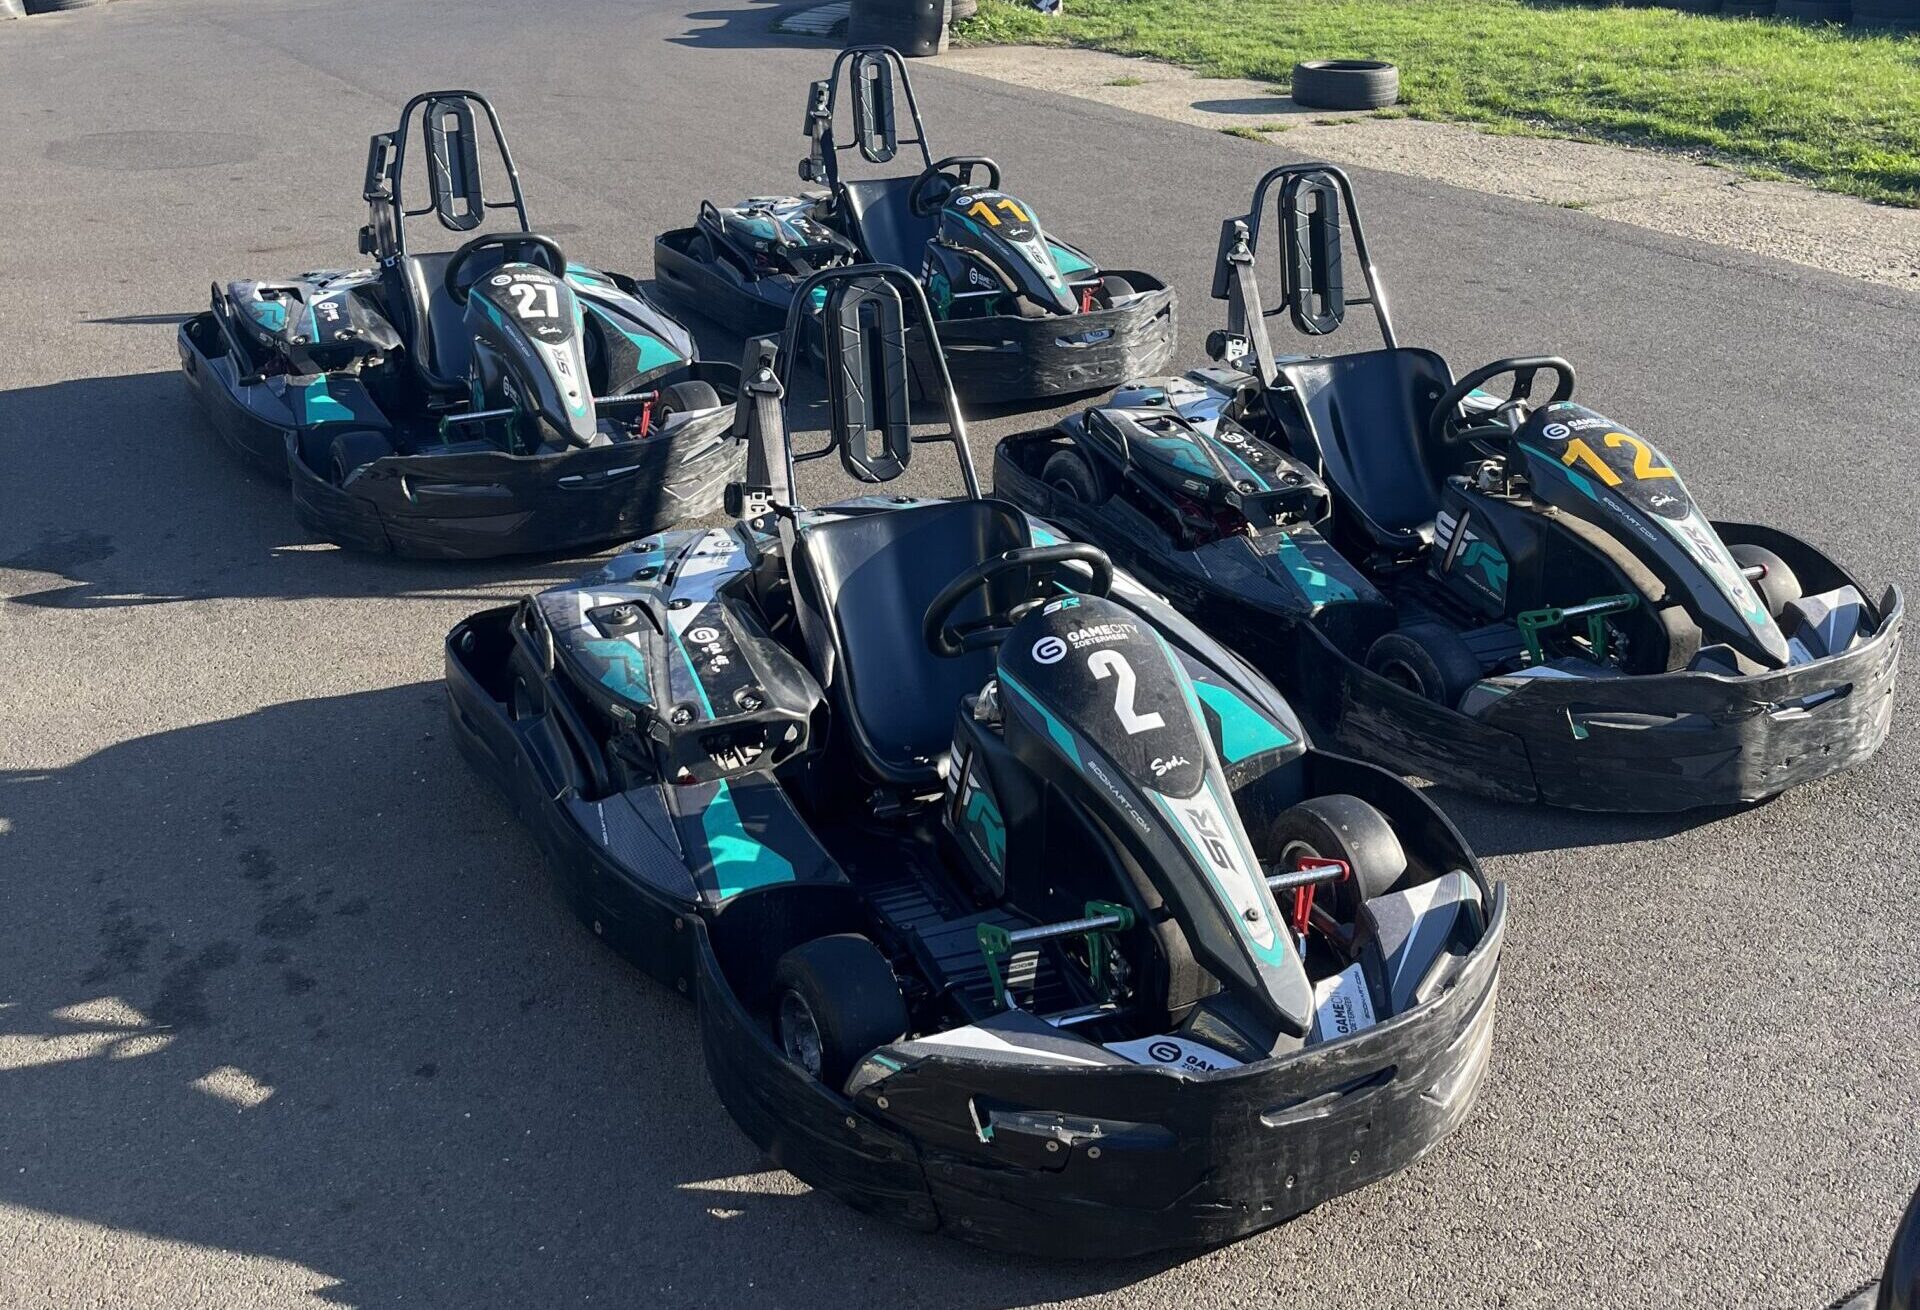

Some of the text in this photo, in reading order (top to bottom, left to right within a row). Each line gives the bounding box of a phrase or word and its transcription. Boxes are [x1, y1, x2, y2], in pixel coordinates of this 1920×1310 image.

[967, 198, 1029, 226] 11
[509, 283, 559, 319] 27
[1561, 432, 1676, 487] 12
[1066, 623, 1140, 643] GAMECITY
[1072, 632, 1130, 650] ZOETERMEER
[1087, 649, 1166, 735] 2
[1087, 760, 1151, 833] SODIKART.COM
